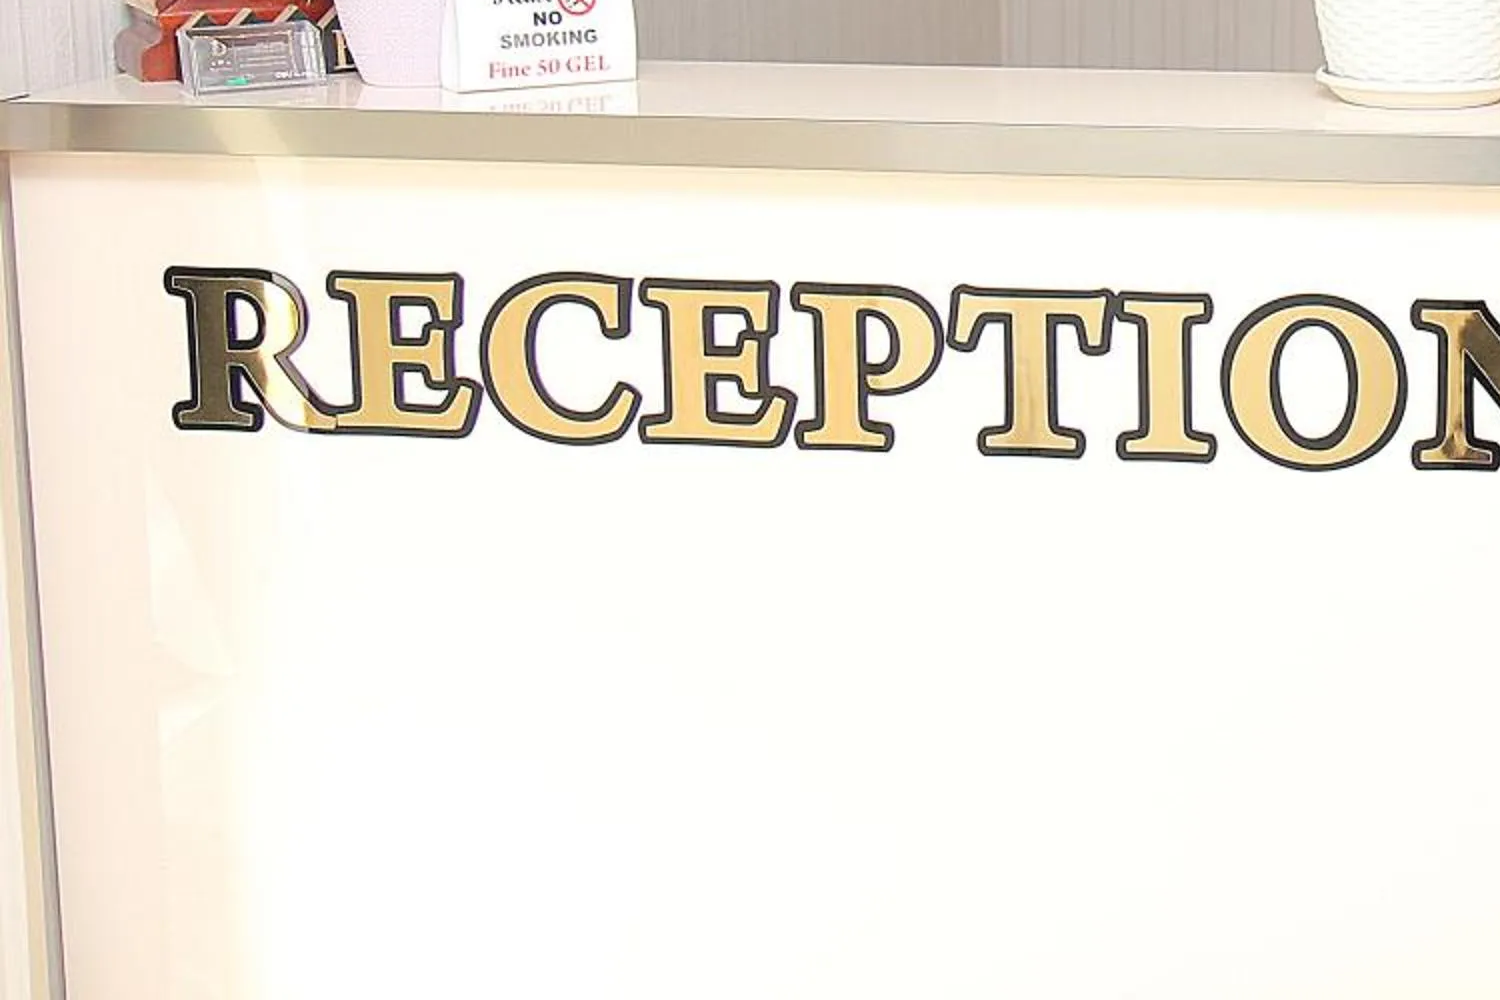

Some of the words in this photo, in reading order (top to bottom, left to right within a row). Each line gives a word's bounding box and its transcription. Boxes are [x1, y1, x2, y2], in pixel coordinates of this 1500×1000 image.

[532, 11, 563, 27] NO
[500, 28, 599, 51] SMOKING
[488, 61, 532, 80] Fine
[536, 58, 561, 77] 50
[565, 54, 612, 74] GEL
